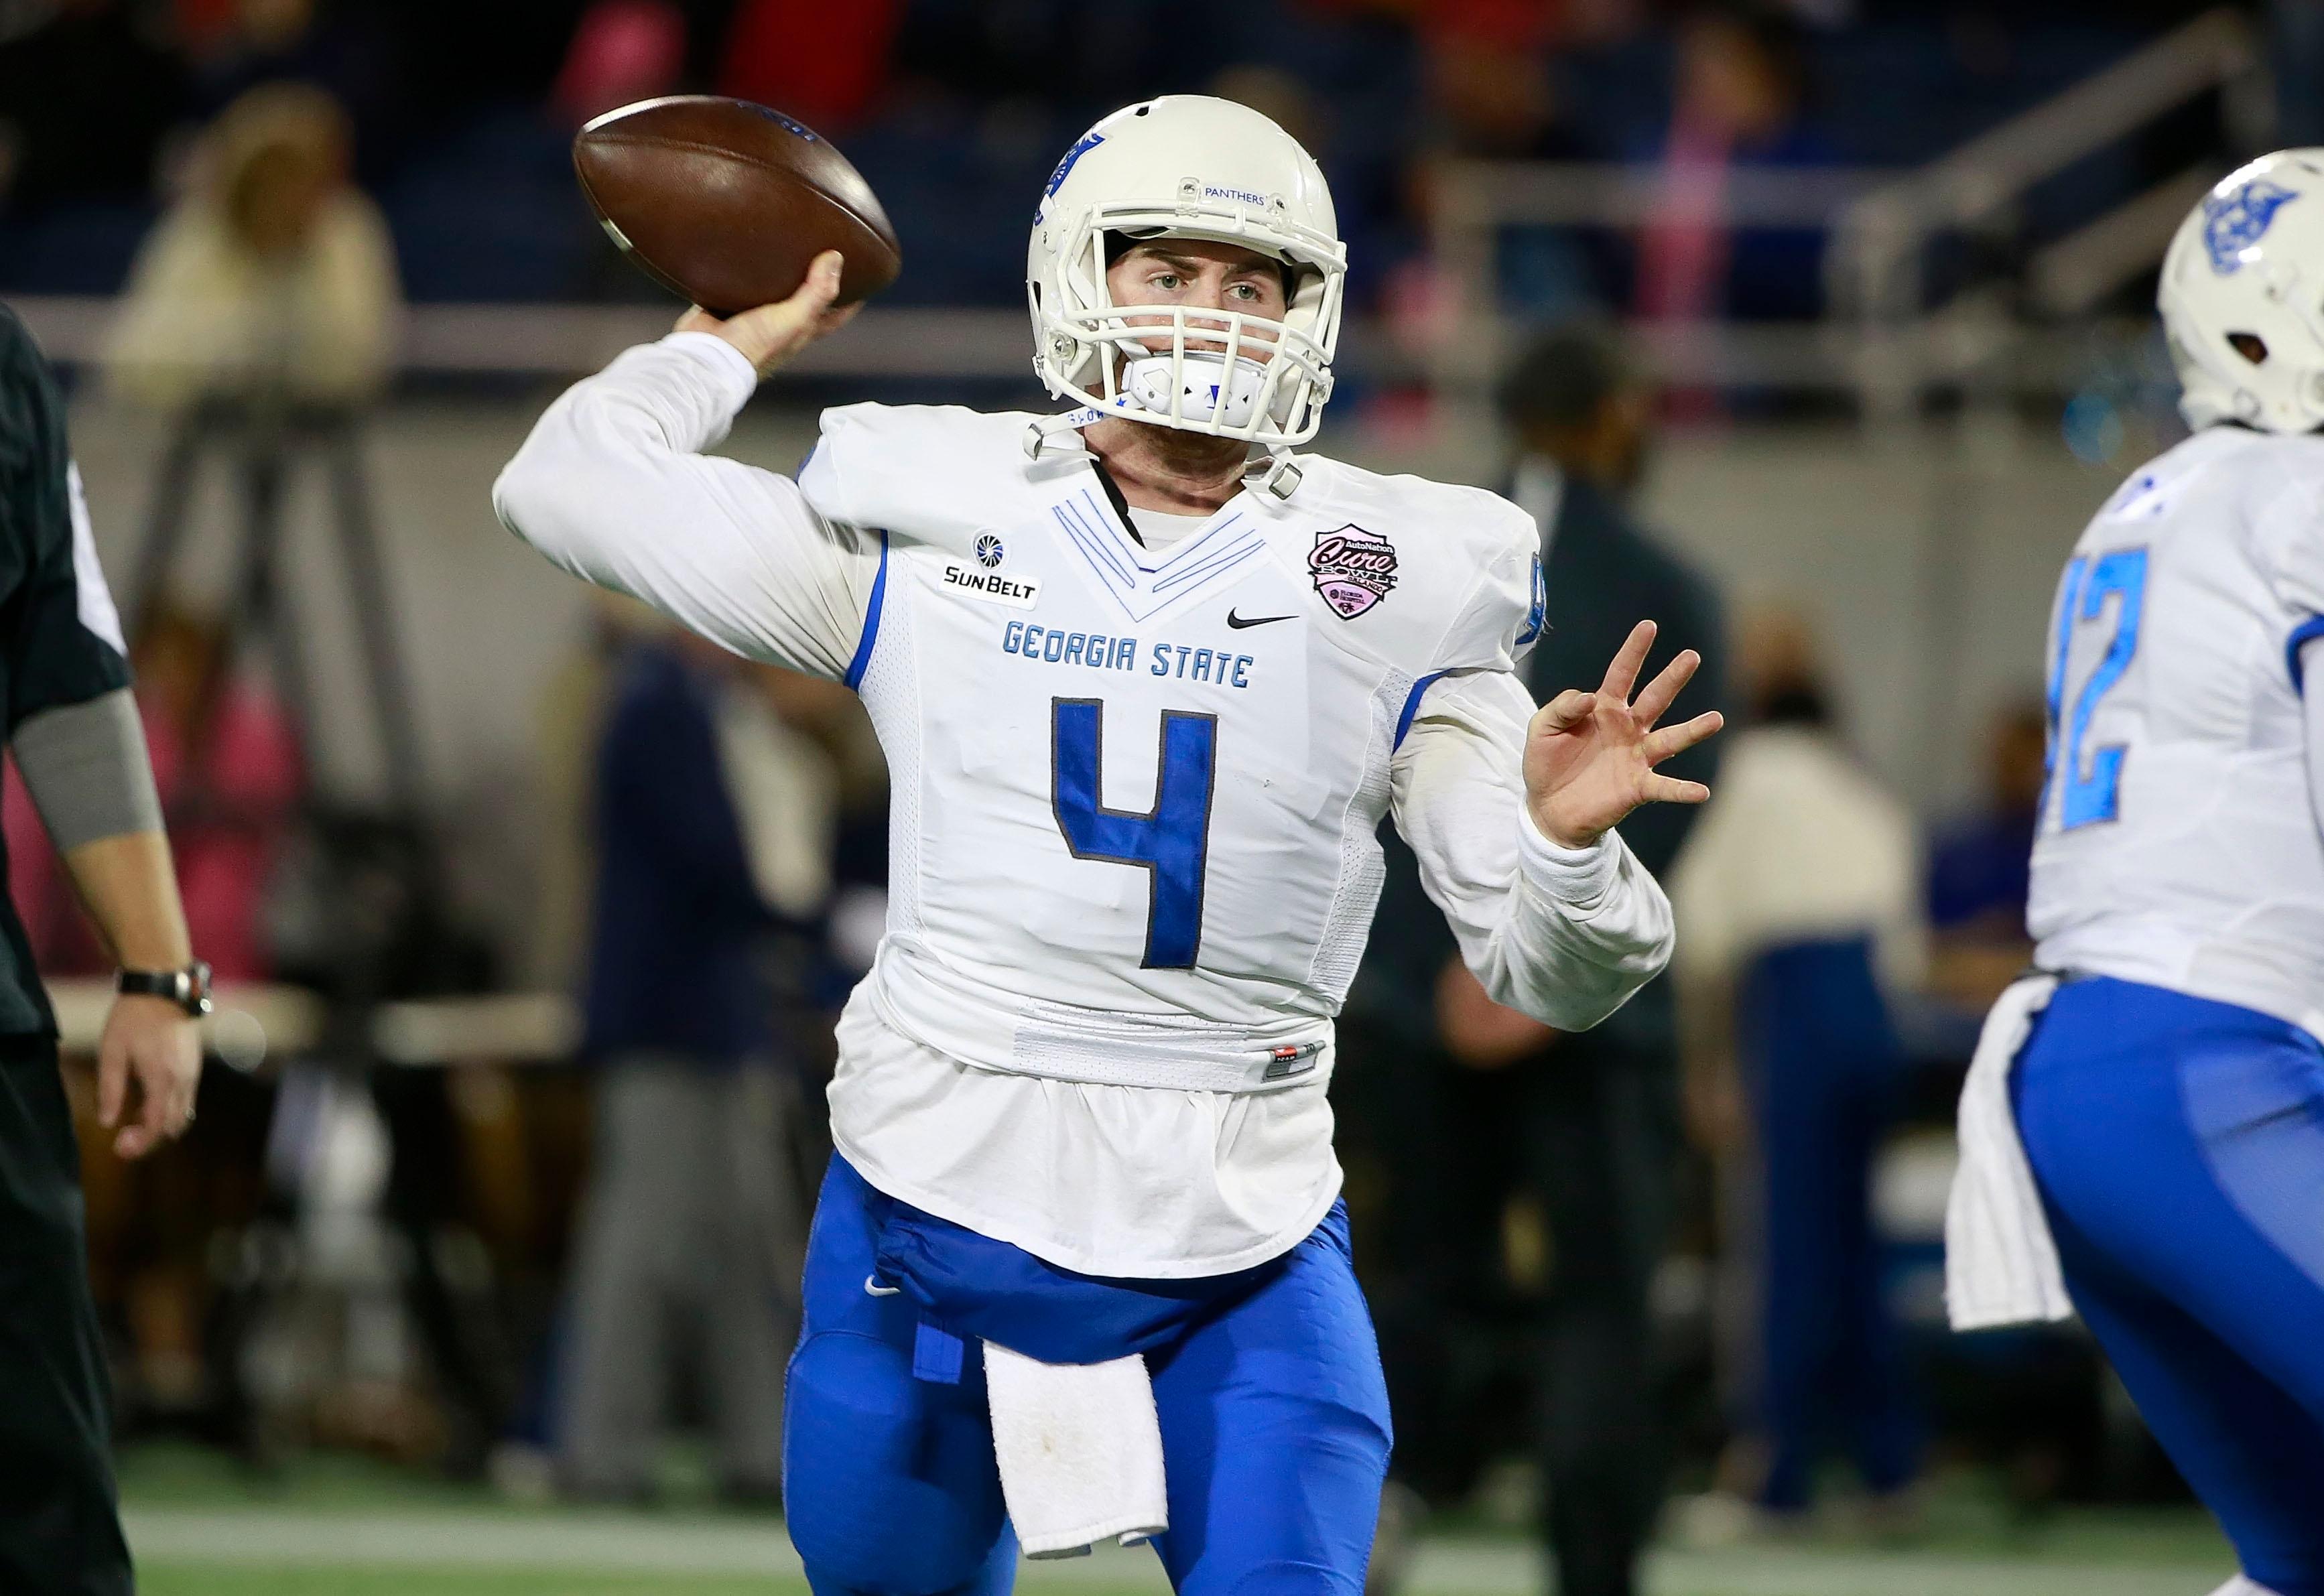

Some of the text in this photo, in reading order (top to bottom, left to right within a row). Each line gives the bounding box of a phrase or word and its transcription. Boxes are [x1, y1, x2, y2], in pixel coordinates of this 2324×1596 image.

[1205, 187, 1265, 206] PANTHERS
[1309, 537, 1395, 573] Cure
[1346, 540, 1394, 553] AutoNation
[1316, 565, 1389, 583] BOWL
[1004, 620, 1254, 688] GEORGIA STATE
[1050, 695, 1218, 970] 4
